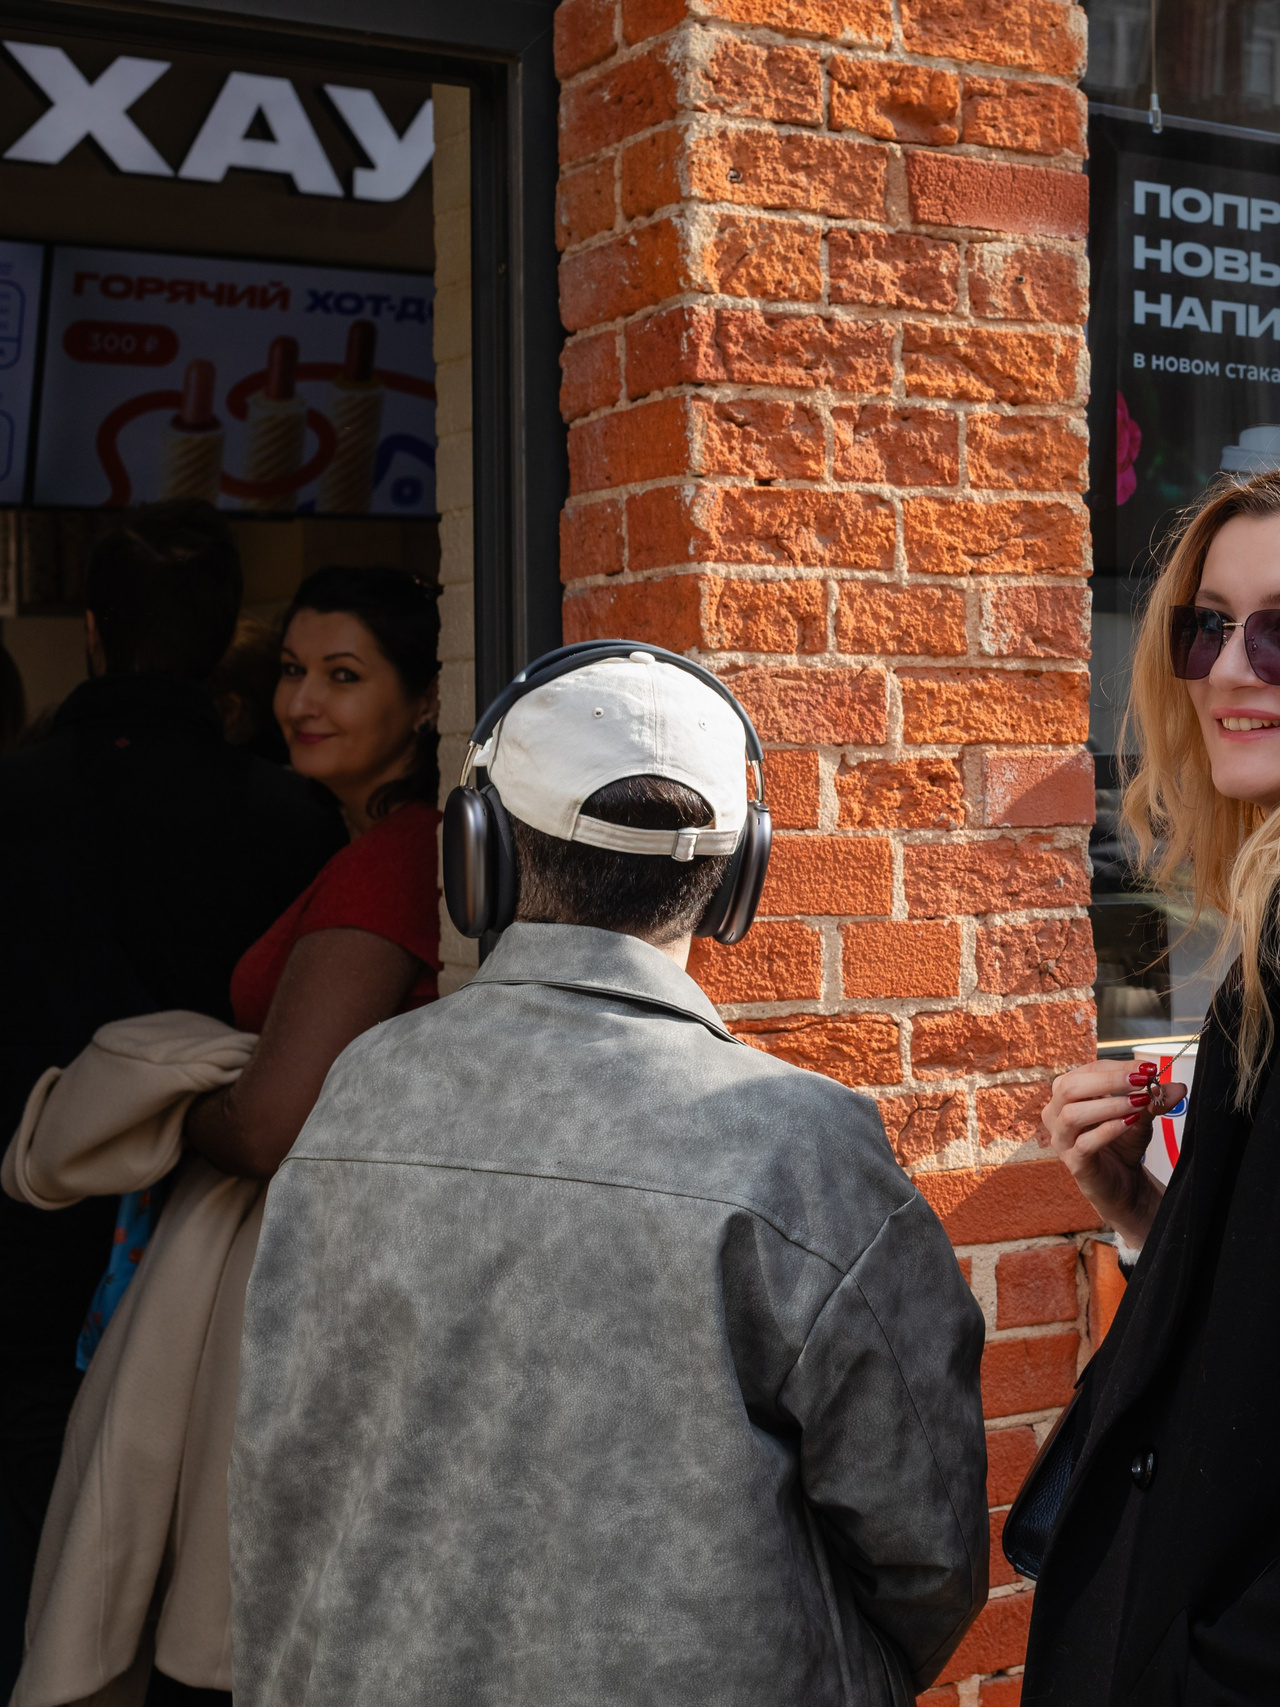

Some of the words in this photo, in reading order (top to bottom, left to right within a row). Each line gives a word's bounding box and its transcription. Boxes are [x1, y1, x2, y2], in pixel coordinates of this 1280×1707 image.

[2, 40, 435, 201] ХАУ
[72, 271, 291, 311] ГОРЯЧИЙ
[86, 331, 138, 354] 300
[1151, 354, 1220, 377] новом
